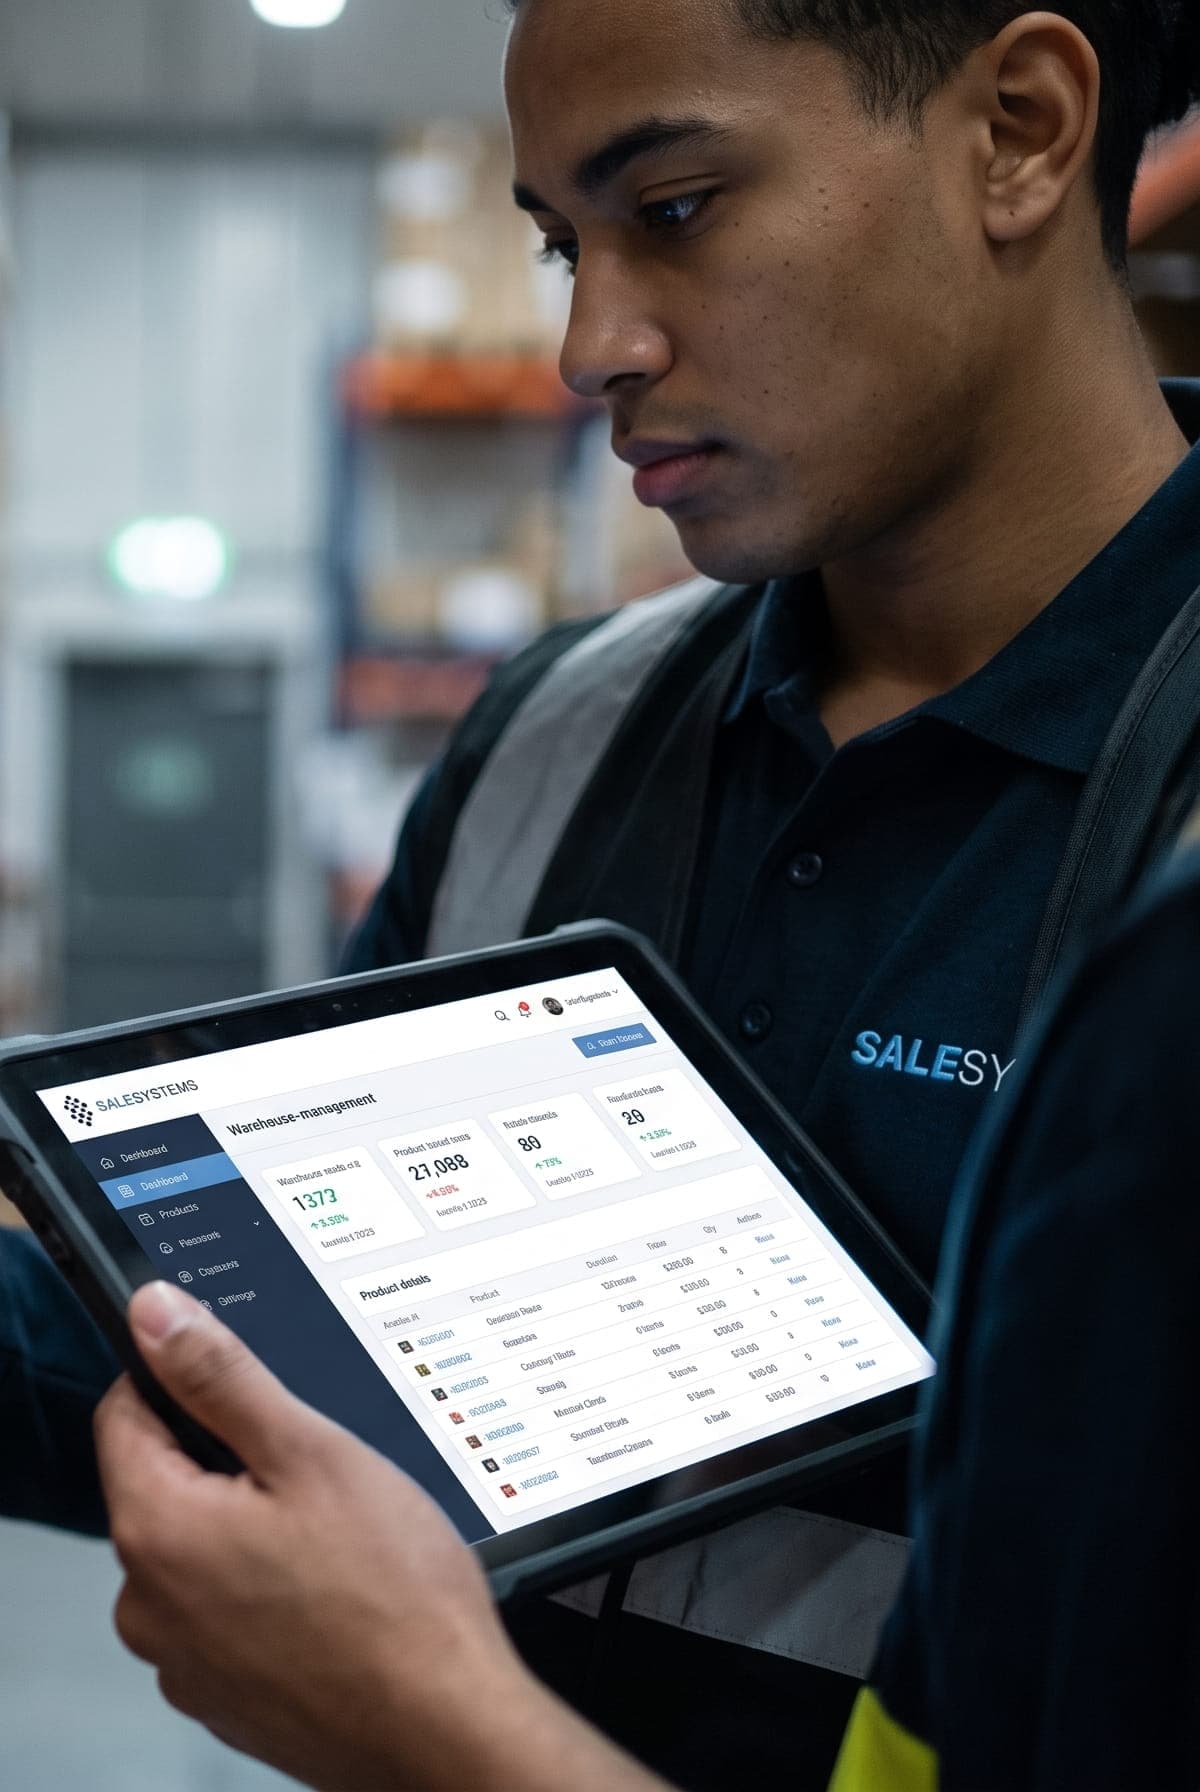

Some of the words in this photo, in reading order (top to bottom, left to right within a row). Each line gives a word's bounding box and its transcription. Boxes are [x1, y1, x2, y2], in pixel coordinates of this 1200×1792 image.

[96, 1080, 198, 1111] SALESYSTEMS
[226, 1093, 377, 1136] Warehouse-management
[518, 1136, 541, 1151] 80
[408, 1154, 469, 1180] 27,088
[292, 1189, 337, 1211] 1373
[360, 1283, 400, 1301] Product
